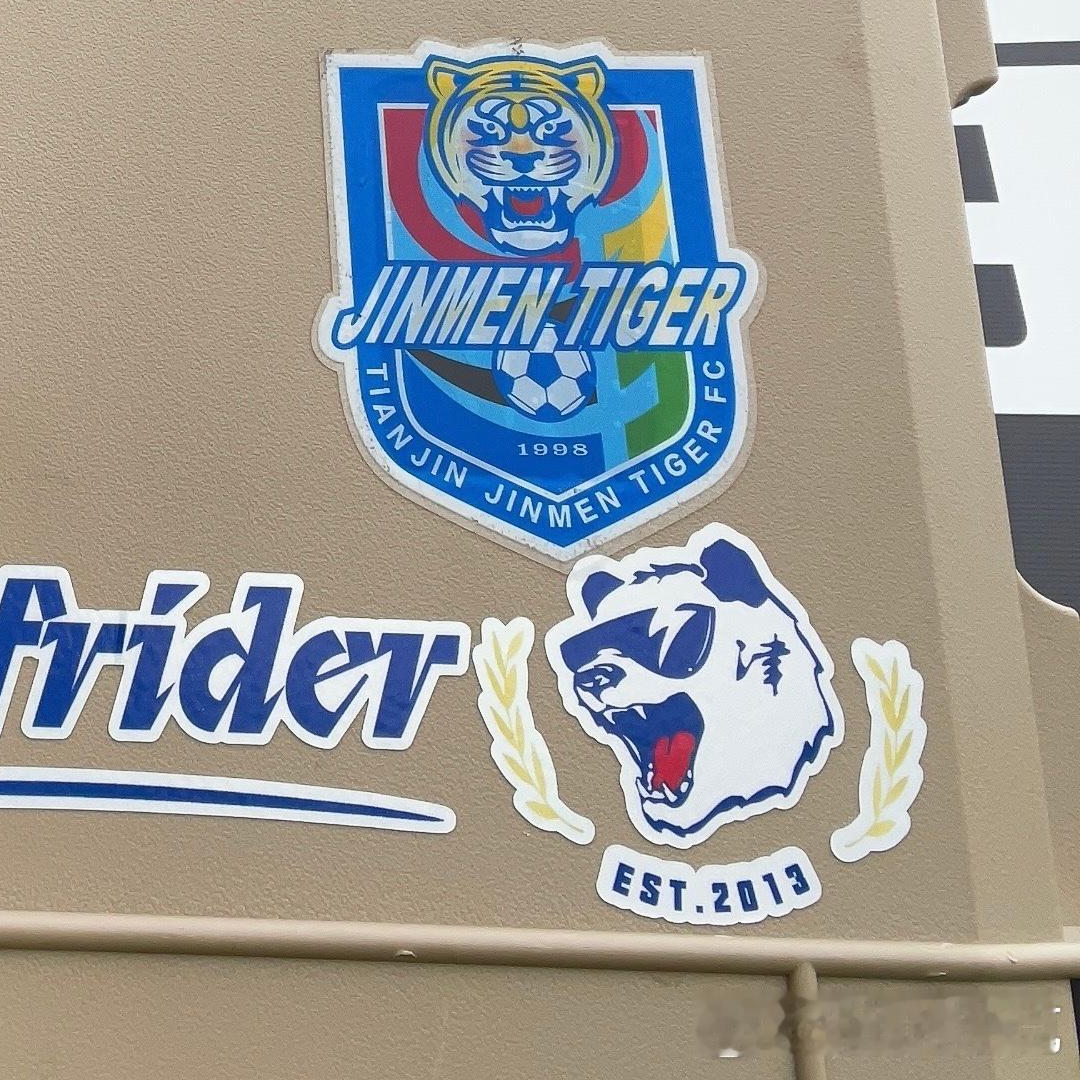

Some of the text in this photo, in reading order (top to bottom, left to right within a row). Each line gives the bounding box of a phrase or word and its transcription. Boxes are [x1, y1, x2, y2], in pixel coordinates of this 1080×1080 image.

[336, 265, 741, 346] JINMEN TIGER
[365, 358, 727, 528] TIANJIN JINMEN TIGER FC
[516, 442, 589, 457] 1998
[735, 633, 791, 697] 津
[611, 861, 811, 914] EST.2013
